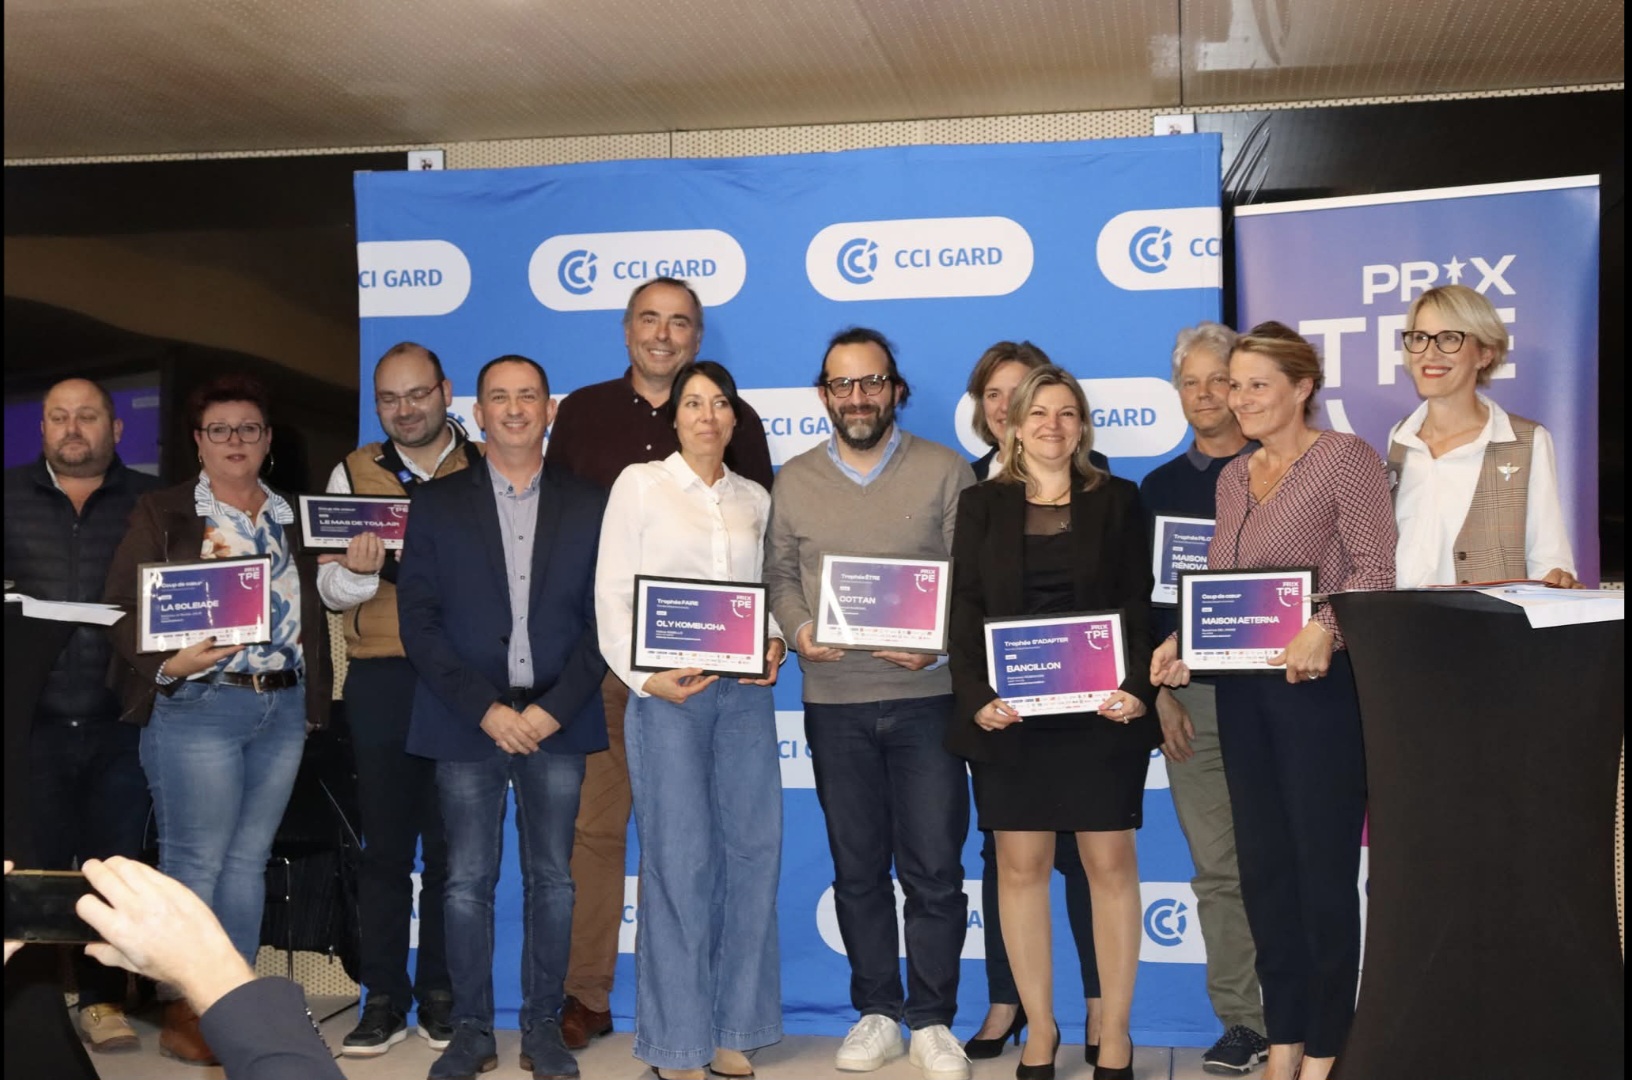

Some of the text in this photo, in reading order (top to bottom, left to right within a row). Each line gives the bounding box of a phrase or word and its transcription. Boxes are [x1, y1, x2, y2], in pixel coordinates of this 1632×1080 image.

[894, 246, 1003, 270] CCI GARD
[613, 258, 717, 280] CCI GARD
[358, 268, 443, 288] CI GARD
[1090, 407, 1157, 428] GARD
[799, 416, 831, 435] GA
[1172, 554, 1208, 563] MAISON
[1171, 561, 1209, 570] RÉNOVA
[238, 571, 260, 581] TPE
[914, 573, 936, 583] TPE
[1276, 587, 1299, 596] TPE
[730, 600, 752, 609] TPE
[839, 595, 876, 604] COTTAN
[160, 604, 174, 612] LA
[656, 620, 726, 631] OLY KOMBUCHA
[1201, 616, 1280, 625] MAISON AETERNA
[1084, 630, 1109, 640] TPE
[1006, 661, 1062, 673] BANCILLON
